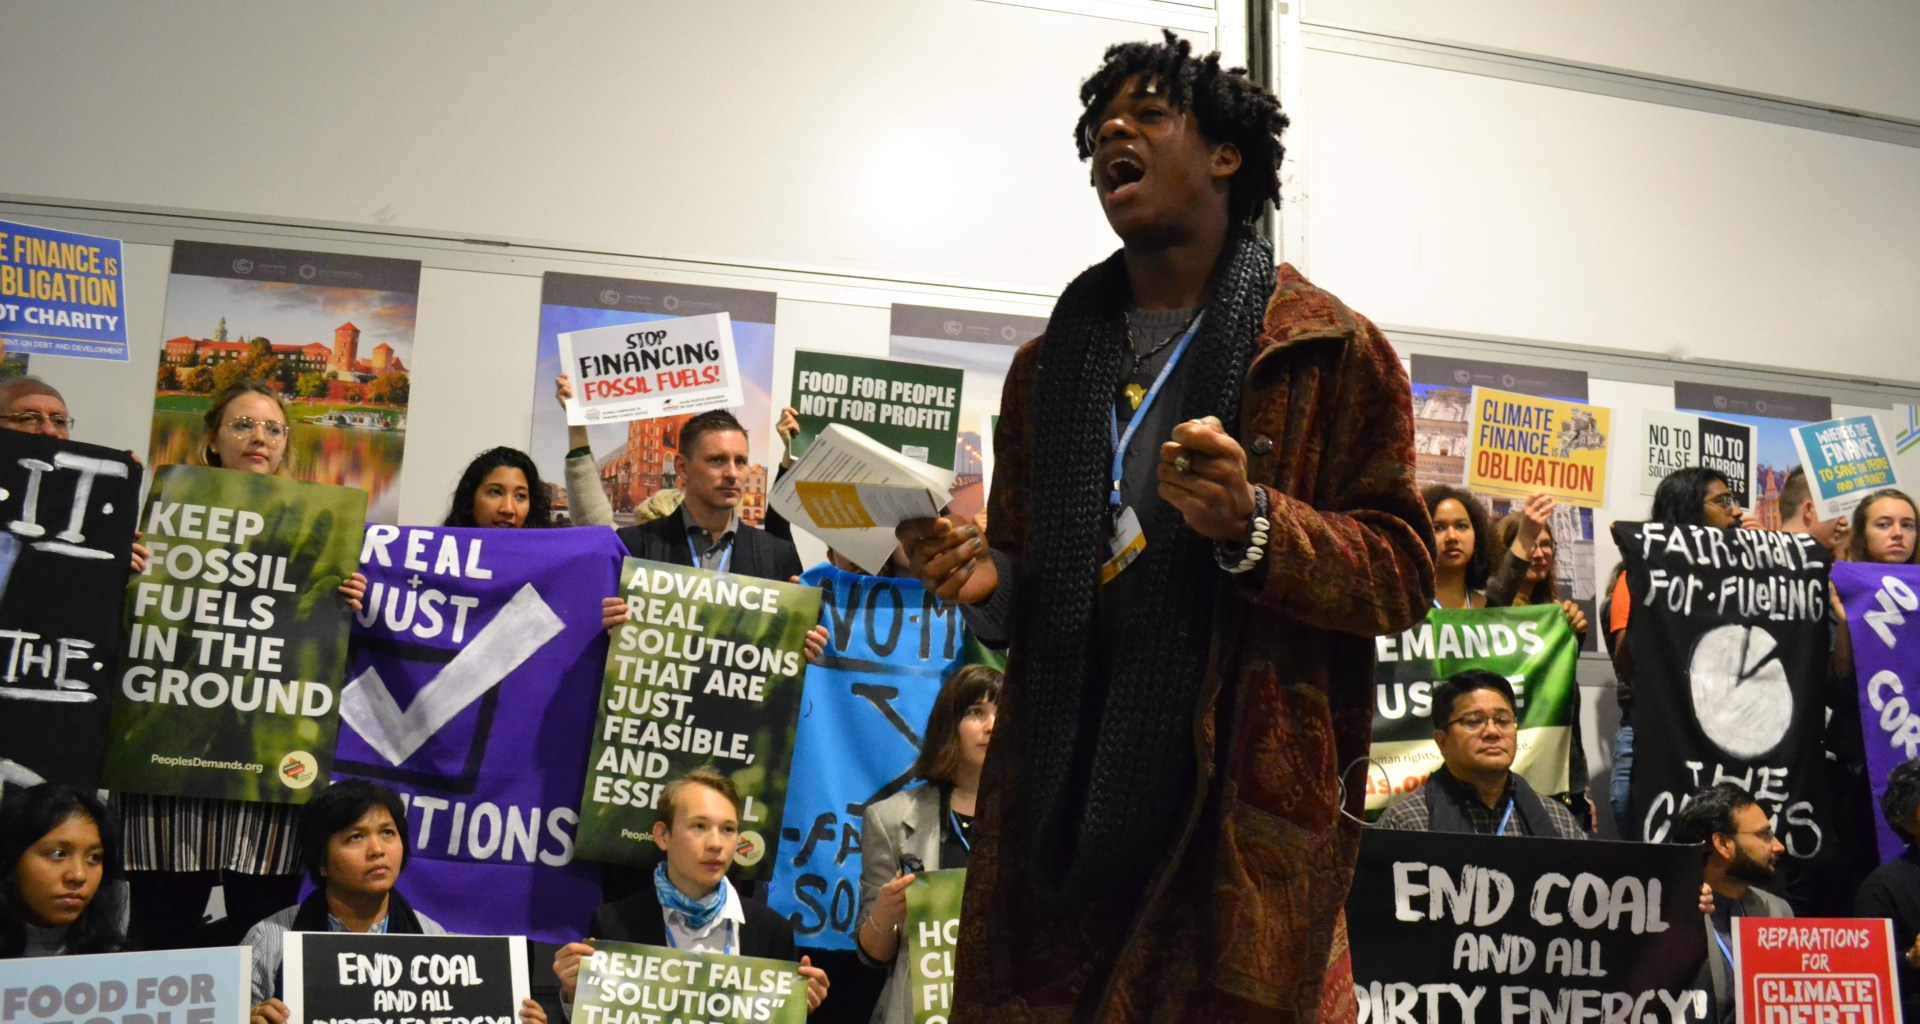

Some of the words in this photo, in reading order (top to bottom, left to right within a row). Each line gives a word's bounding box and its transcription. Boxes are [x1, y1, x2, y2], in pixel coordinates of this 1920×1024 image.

[14, 235, 101, 274] FINANCE
[104, 257, 118, 276] IS
[0, 264, 117, 308] BLIGATION
[0, 303, 20, 322] OT
[24, 307, 119, 332] CHARITY
[34, 341, 53, 349] DEBT
[72, 345, 123, 354] DEVELOPMENT
[626, 330, 667, 349] STOP
[579, 340, 719, 379] FINANCING
[584, 376, 652, 401] FOSSIL
[656, 365, 720, 392] FUELS!
[798, 371, 848, 395] FOOD
[851, 376, 887, 400] FOR
[890, 381, 956, 408] PEOPLE
[799, 394, 838, 418] NOT
[840, 399, 877, 423] FOR
[879, 404, 951, 431] PROFIT!
[1482, 399, 1554, 431] CLIMATE
[1854, 423, 1869, 436] THE
[1480, 424, 1550, 457] FINANCE
[1552, 447, 1559, 458] IS
[1560, 448, 1570, 459] AN
[1649, 424, 1669, 447] NO
[1673, 428, 1691, 450] TO
[1704, 432, 1723, 457] NO
[1725, 437, 1744, 461] TO
[1820, 436, 1879, 467] FINANCE
[1477, 450, 1594, 492] OBLIGATION
[1649, 447, 1690, 468] FALSE
[1701, 455, 1745, 480] CARBON
[1818, 468, 1834, 483] TO
[1834, 463, 1857, 479] SAVE
[1836, 480, 1854, 493] AND
[1853, 477, 1866, 488] THE
[146, 501, 264, 545] KEEP
[145, 541, 297, 592] FOSSIL
[360, 524, 492, 580] REAL
[134, 582, 276, 630] FUELS
[627, 567, 780, 614] ADVANCE
[356, 582, 479, 644] JUST
[625, 595, 704, 631] REAL
[1863, 575, 1918, 650] NO
[128, 623, 178, 662] IN
[191, 630, 284, 673] THE
[618, 625, 799, 677] SOLUTIONS
[1375, 621, 1545, 662] EMANDS
[122, 666, 333, 717] GROUND
[614, 655, 700, 691] THAT
[703, 670, 767, 702] ARE
[607, 685, 696, 723] JUST,
[1867, 670, 1920, 761] COR
[603, 715, 756, 765] FEASIBLE,
[1403, 750, 1440, 764] rights,
[151, 754, 263, 773] PeoplesDemands.org
[596, 746, 669, 779] AND
[1686, 761, 1788, 801] THE
[402, 793, 580, 867] TIONS
[1393, 861, 1515, 927] END
[1530, 872, 1670, 935] COAL
[919, 918, 960, 947] HO
[1757, 926, 1870, 950] REPARATIONS
[338, 952, 403, 987] END
[410, 954, 484, 987] COAL
[589, 950, 702, 985] REJECT
[708, 963, 793, 995] FALSE
[920, 951, 954, 979] CL
[1453, 932, 1536, 975] AND
[1545, 938, 1608, 977] ALL
[1801, 953, 1831, 972] FOR
[3, 979, 128, 1021] FOOD
[136, 973, 216, 1009] FOR
[374, 989, 417, 1013] AND
[421, 990, 453, 1012] ALL
[1762, 980, 1872, 1003] CLIMATE
